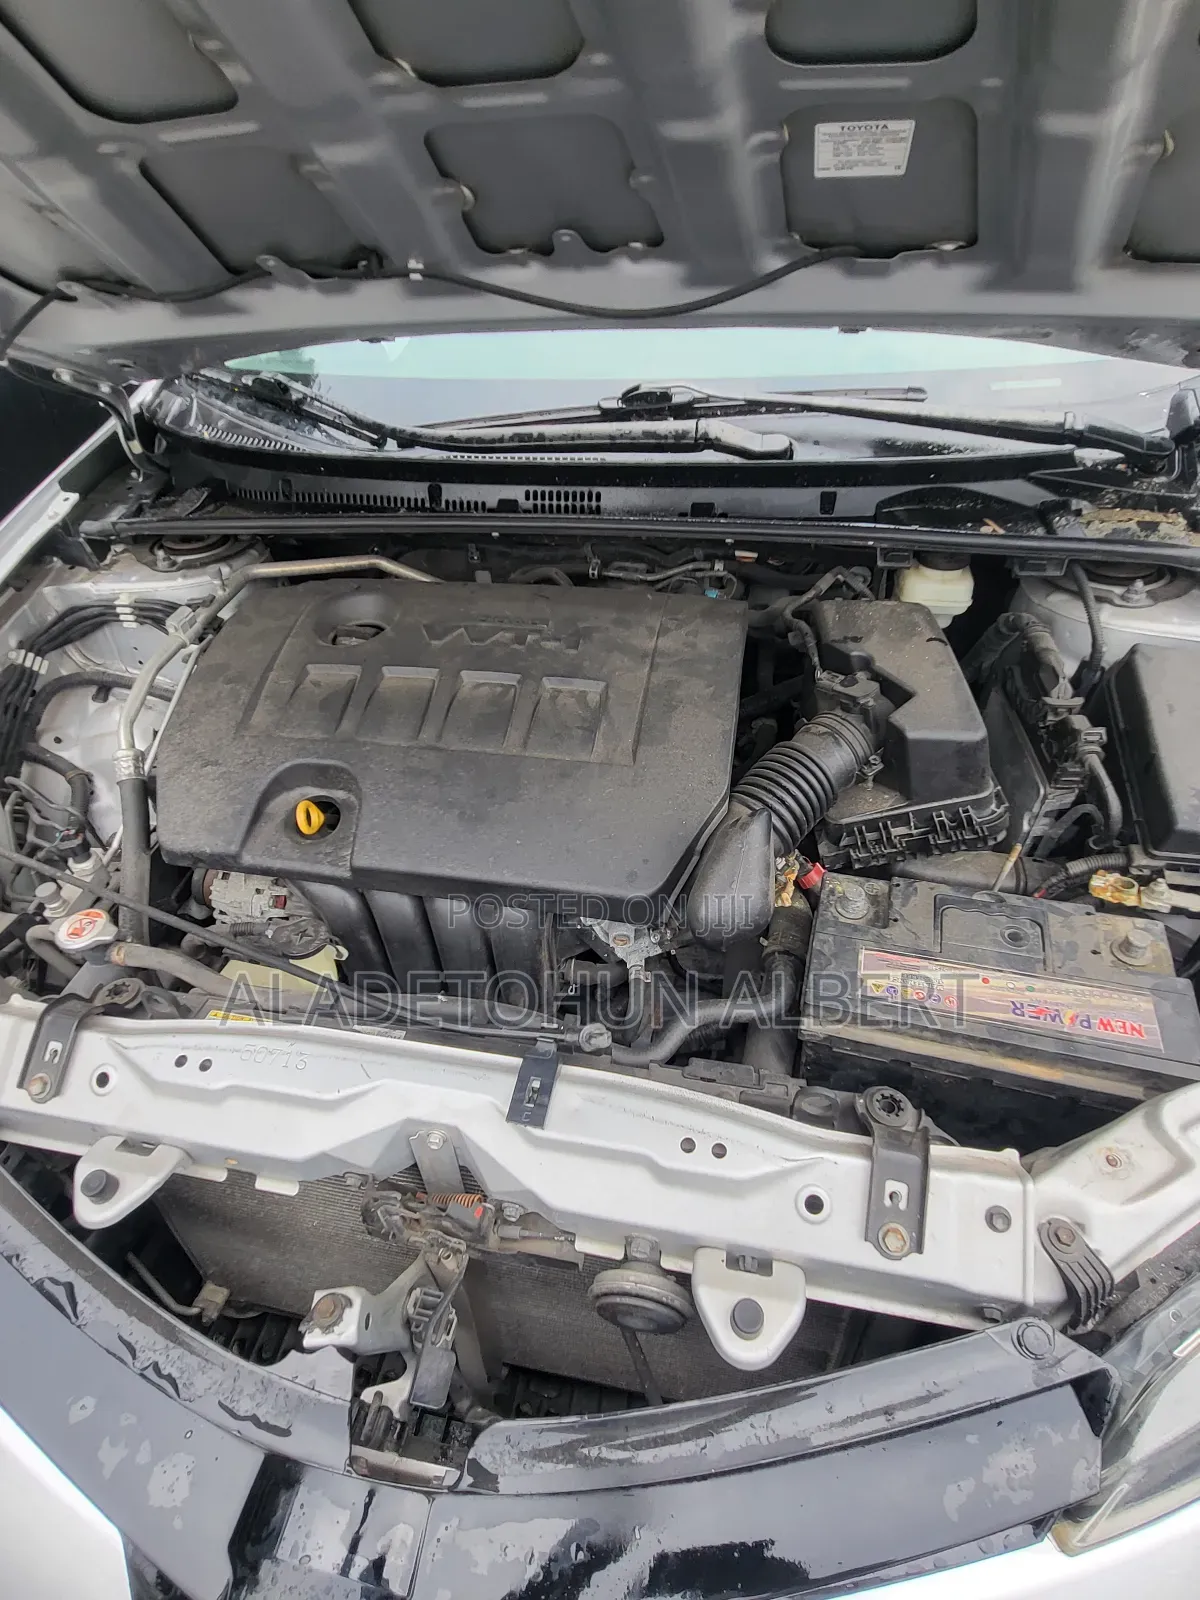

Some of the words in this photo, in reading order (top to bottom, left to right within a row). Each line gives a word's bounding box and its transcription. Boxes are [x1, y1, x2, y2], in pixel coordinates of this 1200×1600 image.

[840, 123, 889, 132] TOYOTA
[1010, 1000, 1092, 1031] POWER
[1096, 1016, 1146, 1039] NEW
